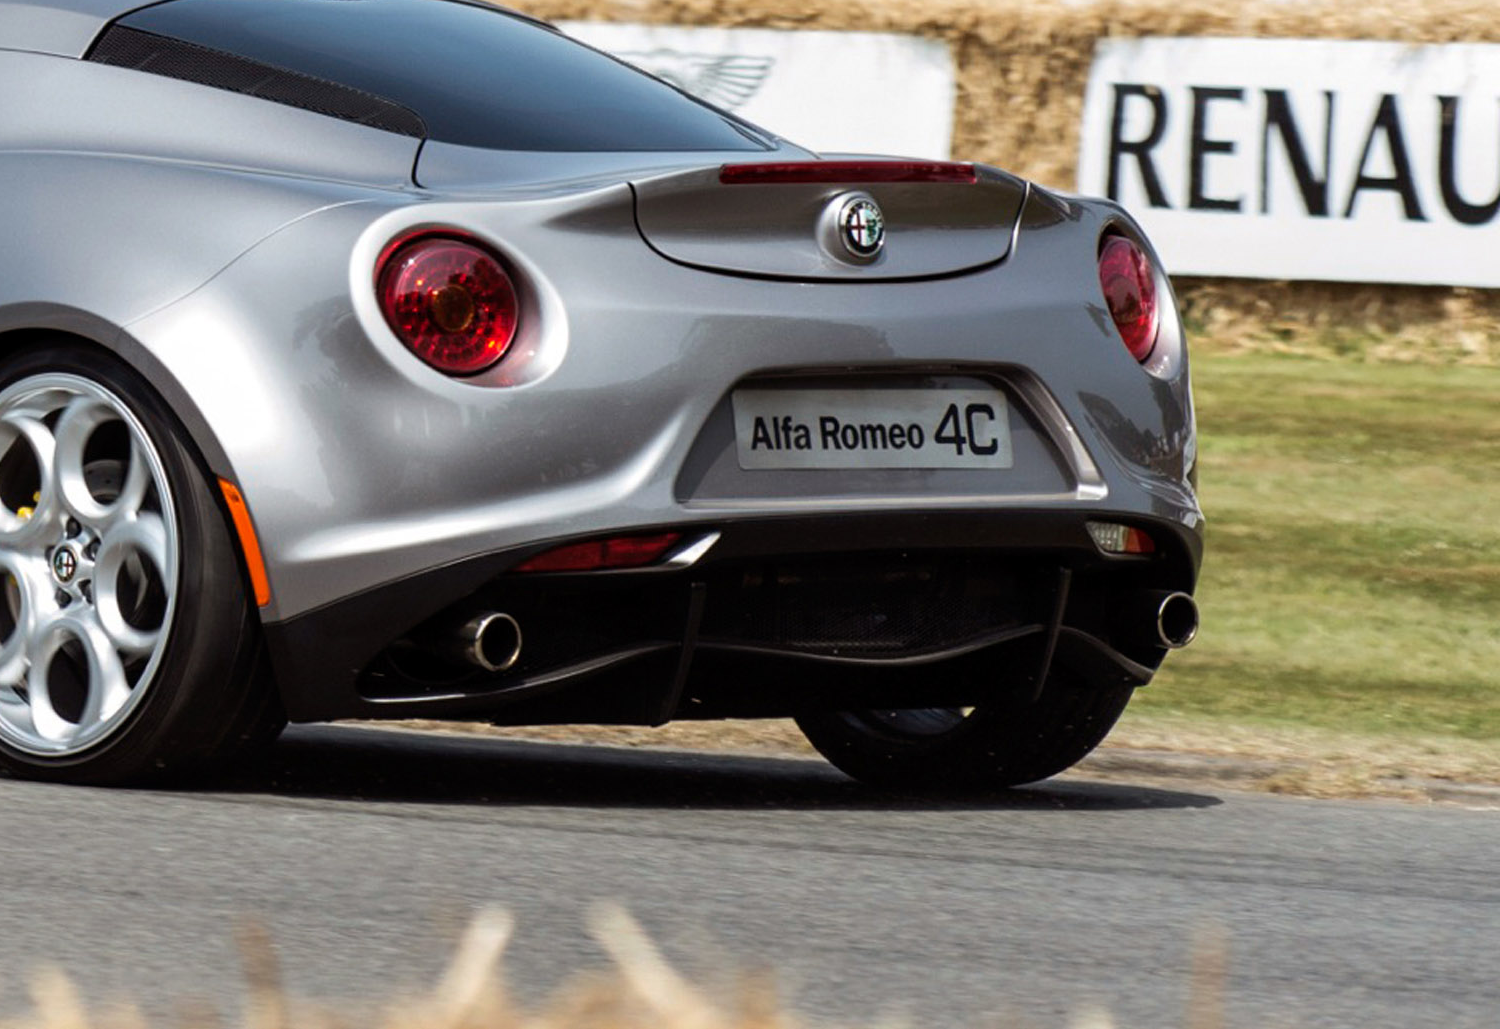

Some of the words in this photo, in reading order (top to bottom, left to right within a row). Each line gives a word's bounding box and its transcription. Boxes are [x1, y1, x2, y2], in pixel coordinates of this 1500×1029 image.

[1106, 82, 1500, 225] RENAU
[751, 416, 812, 450] Alfa
[819, 416, 925, 450] Romeo
[934, 403, 999, 456] 4C
